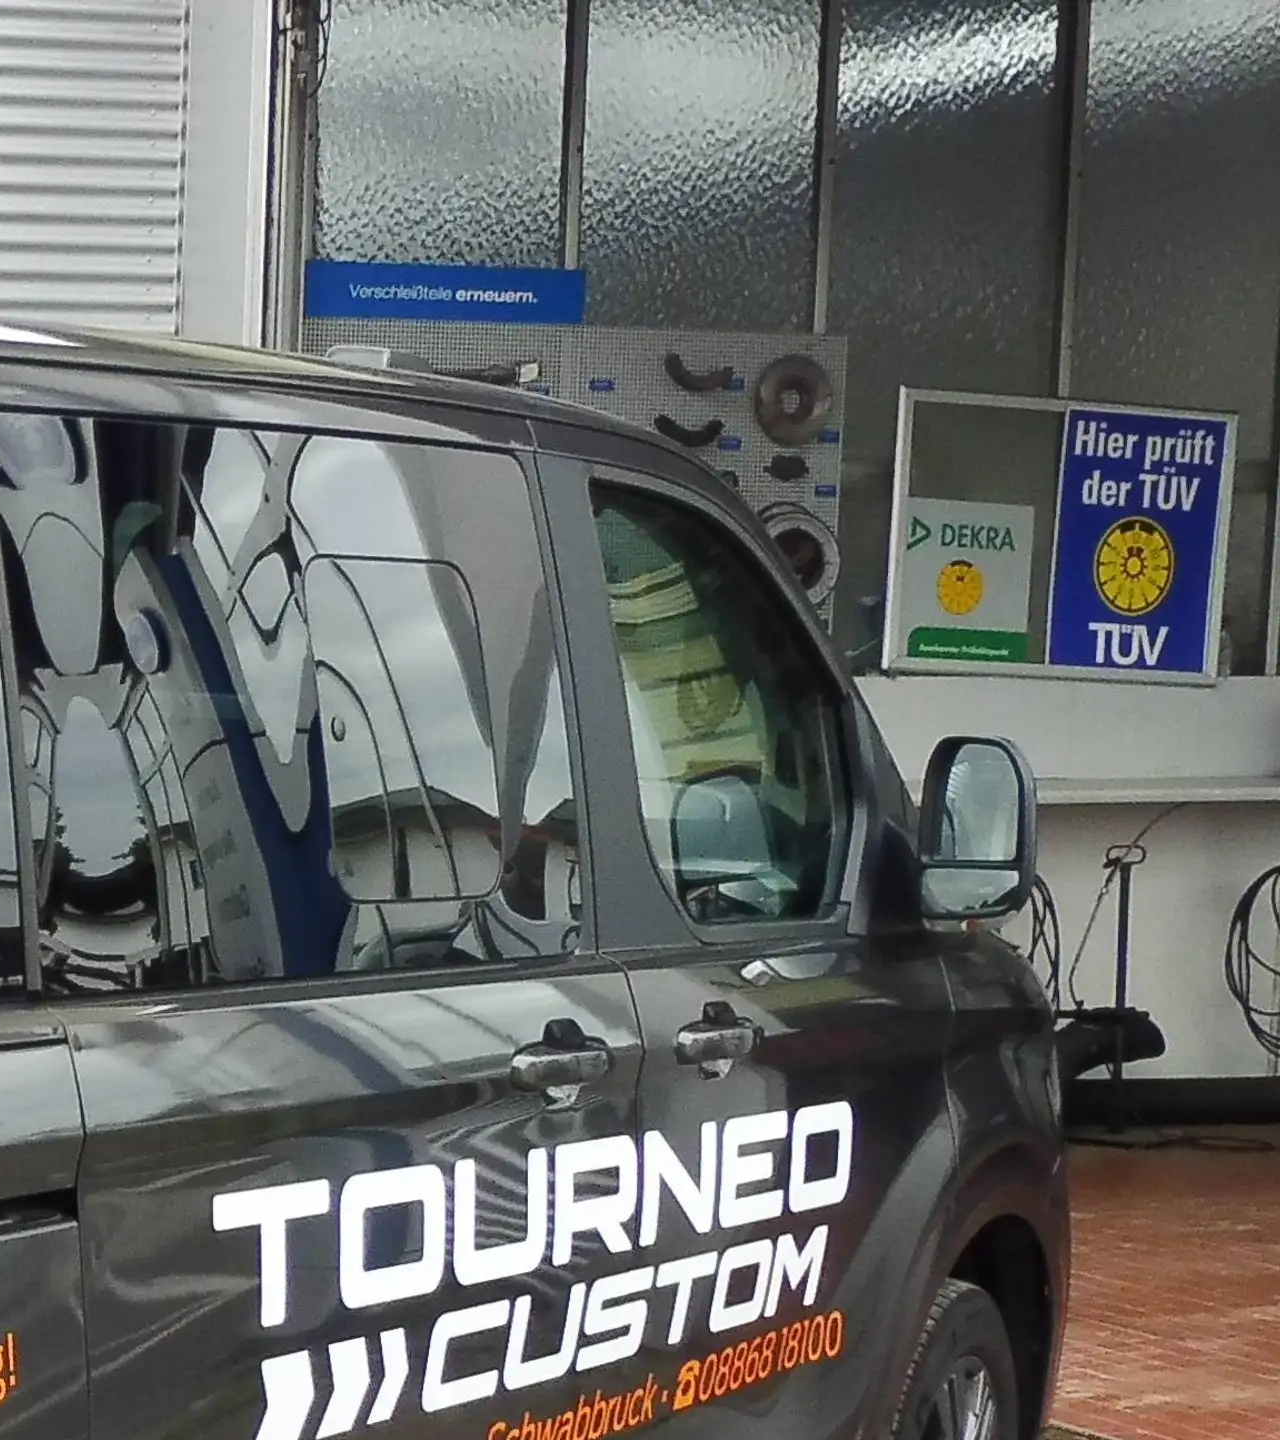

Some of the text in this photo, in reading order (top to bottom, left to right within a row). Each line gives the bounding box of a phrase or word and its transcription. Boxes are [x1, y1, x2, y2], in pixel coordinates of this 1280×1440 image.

[349, 283, 538, 304] Verschleißteile erneuern.
[1074, 419, 1215, 470] Hier prüft
[1082, 466, 1201, 512] der TÜV
[941, 522, 1016, 552] DEKRA
[1088, 621, 1169, 667] TÜV
[212, 1099, 854, 1329] TOURNEO
[420, 1224, 829, 1413] CUSTOM
